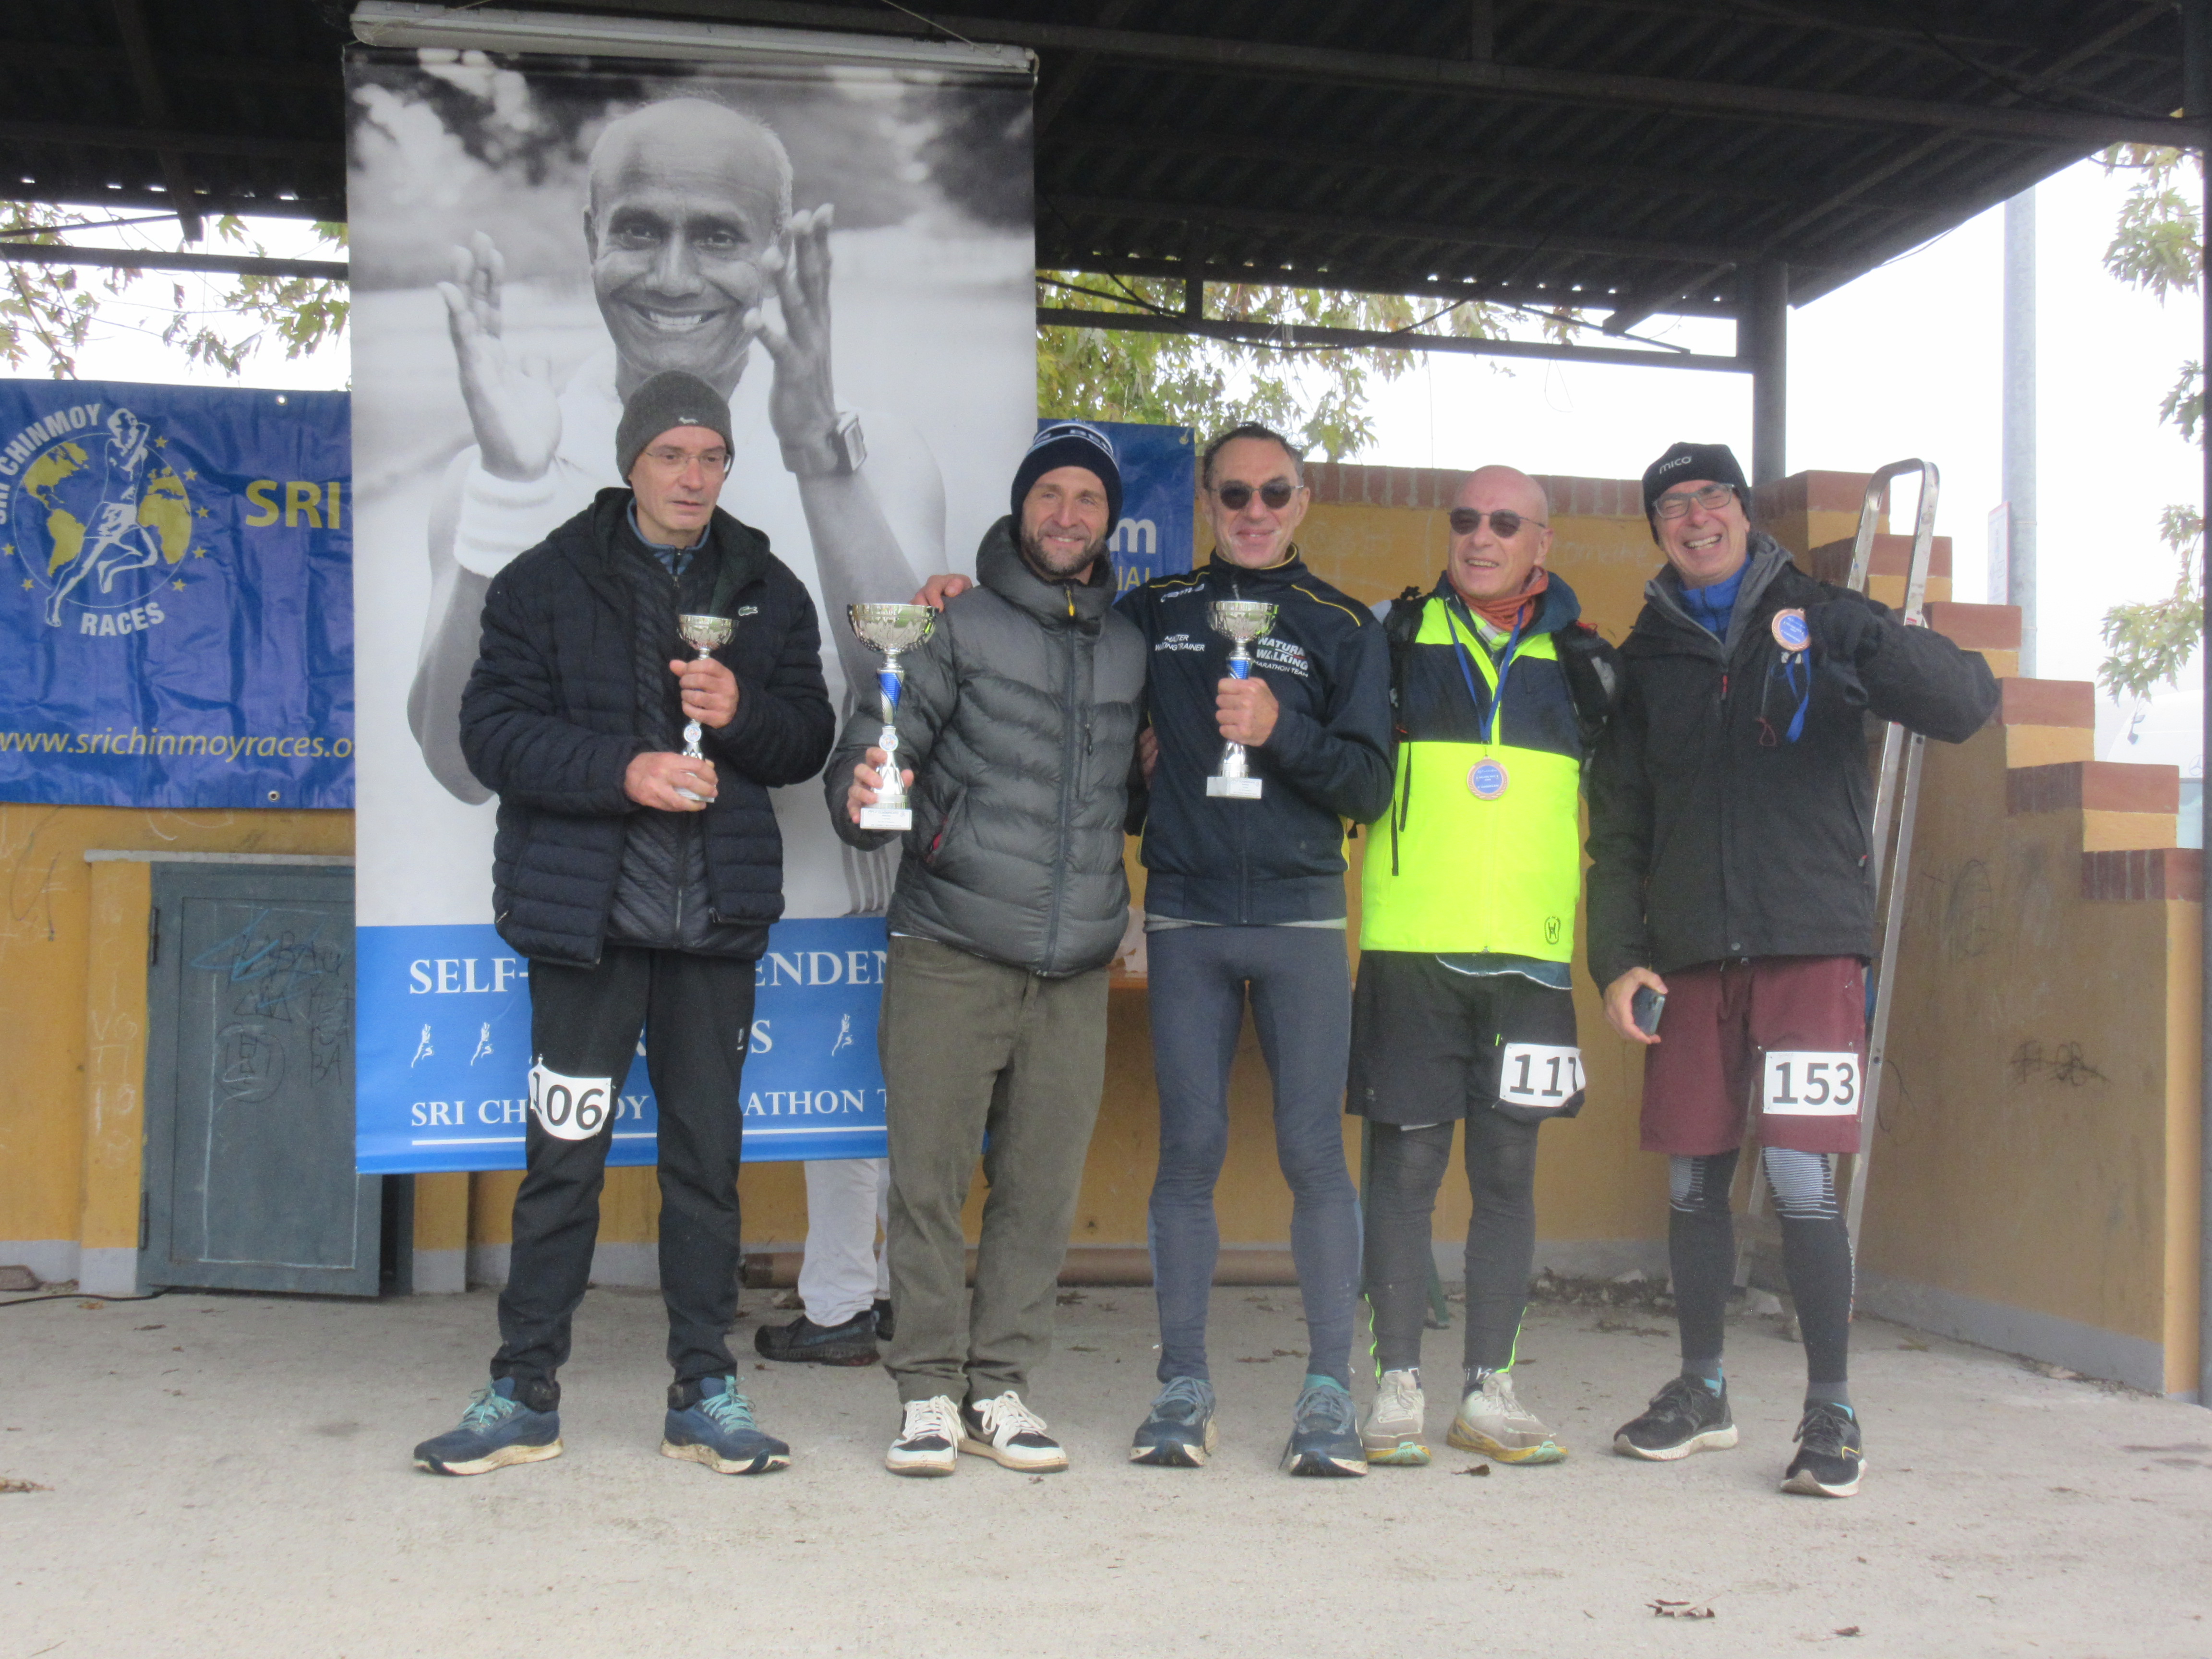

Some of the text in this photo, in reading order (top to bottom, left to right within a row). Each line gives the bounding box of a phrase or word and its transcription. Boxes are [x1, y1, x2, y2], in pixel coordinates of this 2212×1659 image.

[0, 404, 100, 476] CHINMOY
[245, 479, 340, 529] SRI
[80, 602, 165, 636] RACES
[1256, 649, 1309, 671] WALKING
[1258, 637, 1306, 657] NATURA
[531, 1071, 605, 1130] 106
[1772, 1062, 1854, 1106] 153
[411, 1101, 465, 1126] SRI
